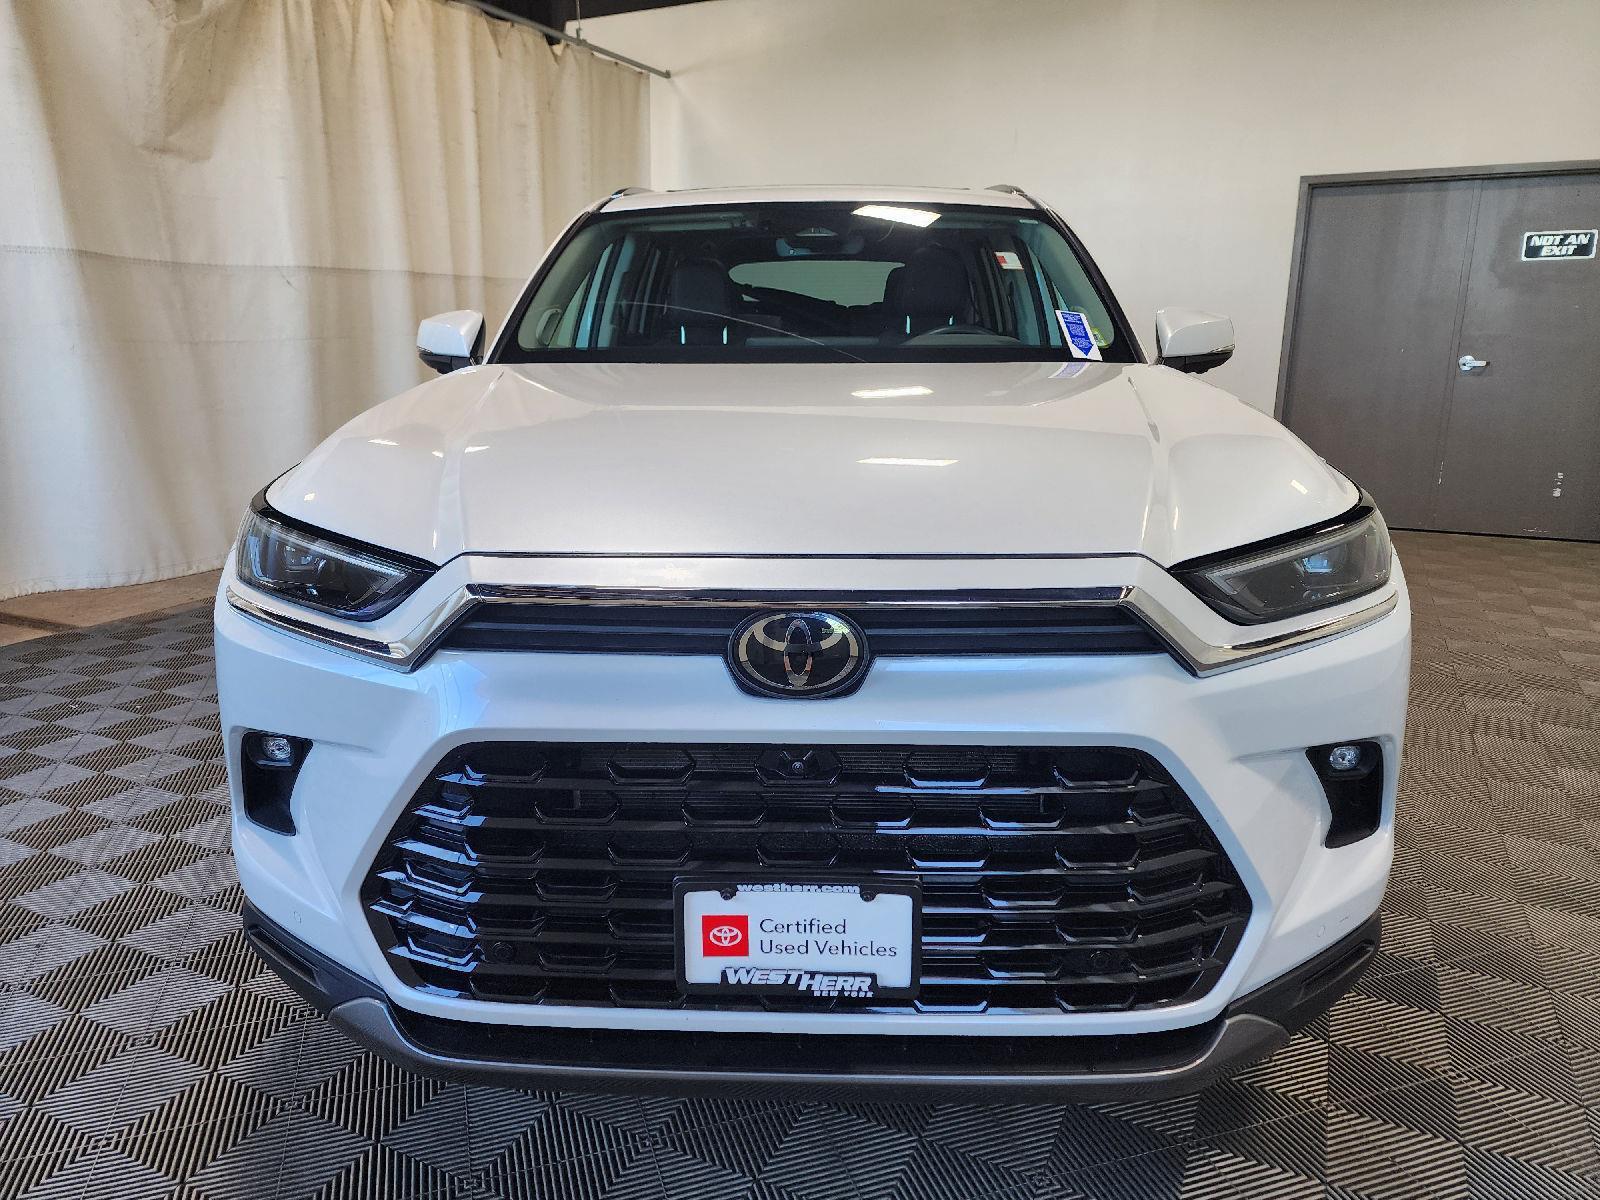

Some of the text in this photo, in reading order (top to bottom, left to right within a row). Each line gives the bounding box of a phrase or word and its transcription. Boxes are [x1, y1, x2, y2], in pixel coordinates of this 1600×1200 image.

[1530, 234, 1590, 246] NOT AN
[1542, 245, 1577, 256] EXIT
[736, 883, 860, 893] westherr.com
[759, 918, 847, 934] Certified
[760, 939, 897, 957] Used Vehicles
